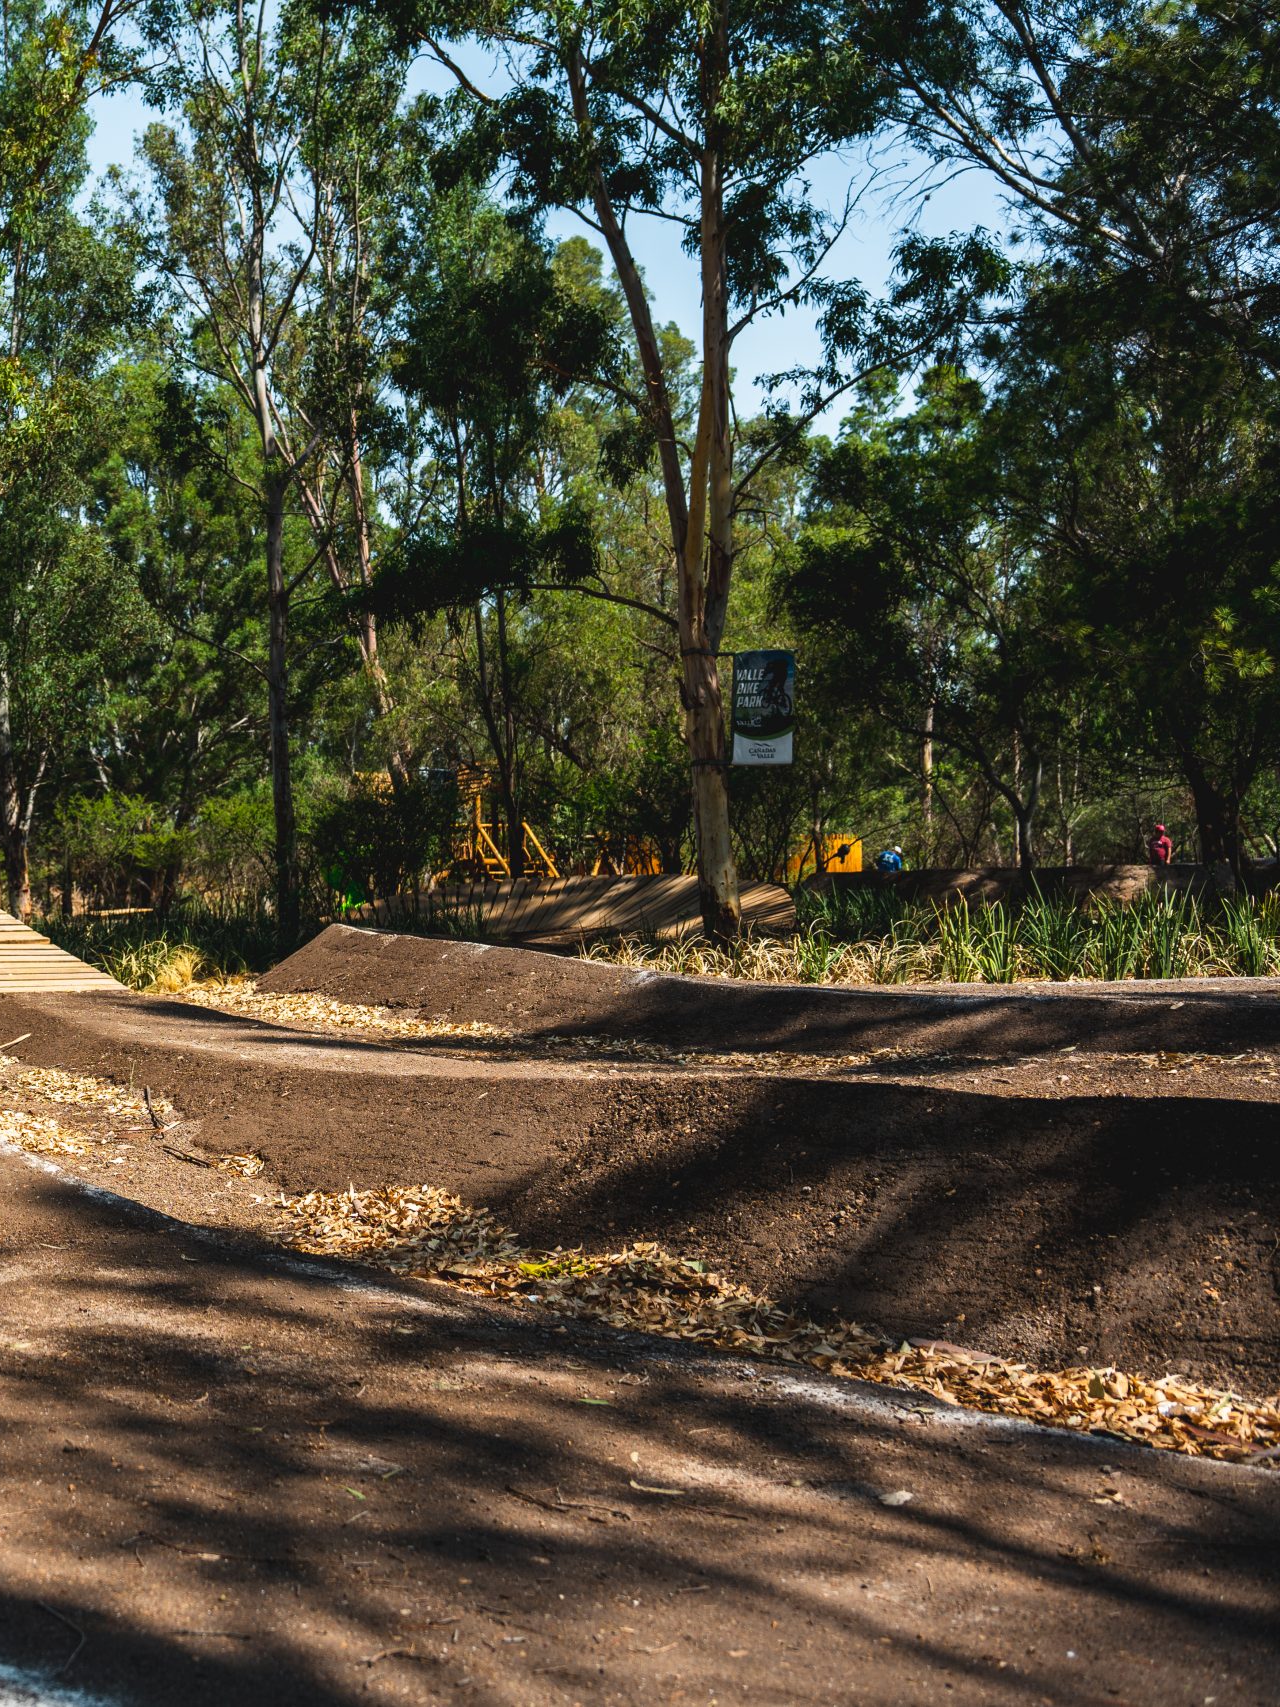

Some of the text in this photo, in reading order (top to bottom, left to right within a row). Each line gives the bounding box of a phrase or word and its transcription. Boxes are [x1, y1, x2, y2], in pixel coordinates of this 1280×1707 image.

[737, 669, 764, 681] VALLE
[737, 682, 759, 694] BIKE
[737, 696, 763, 707] PARK
